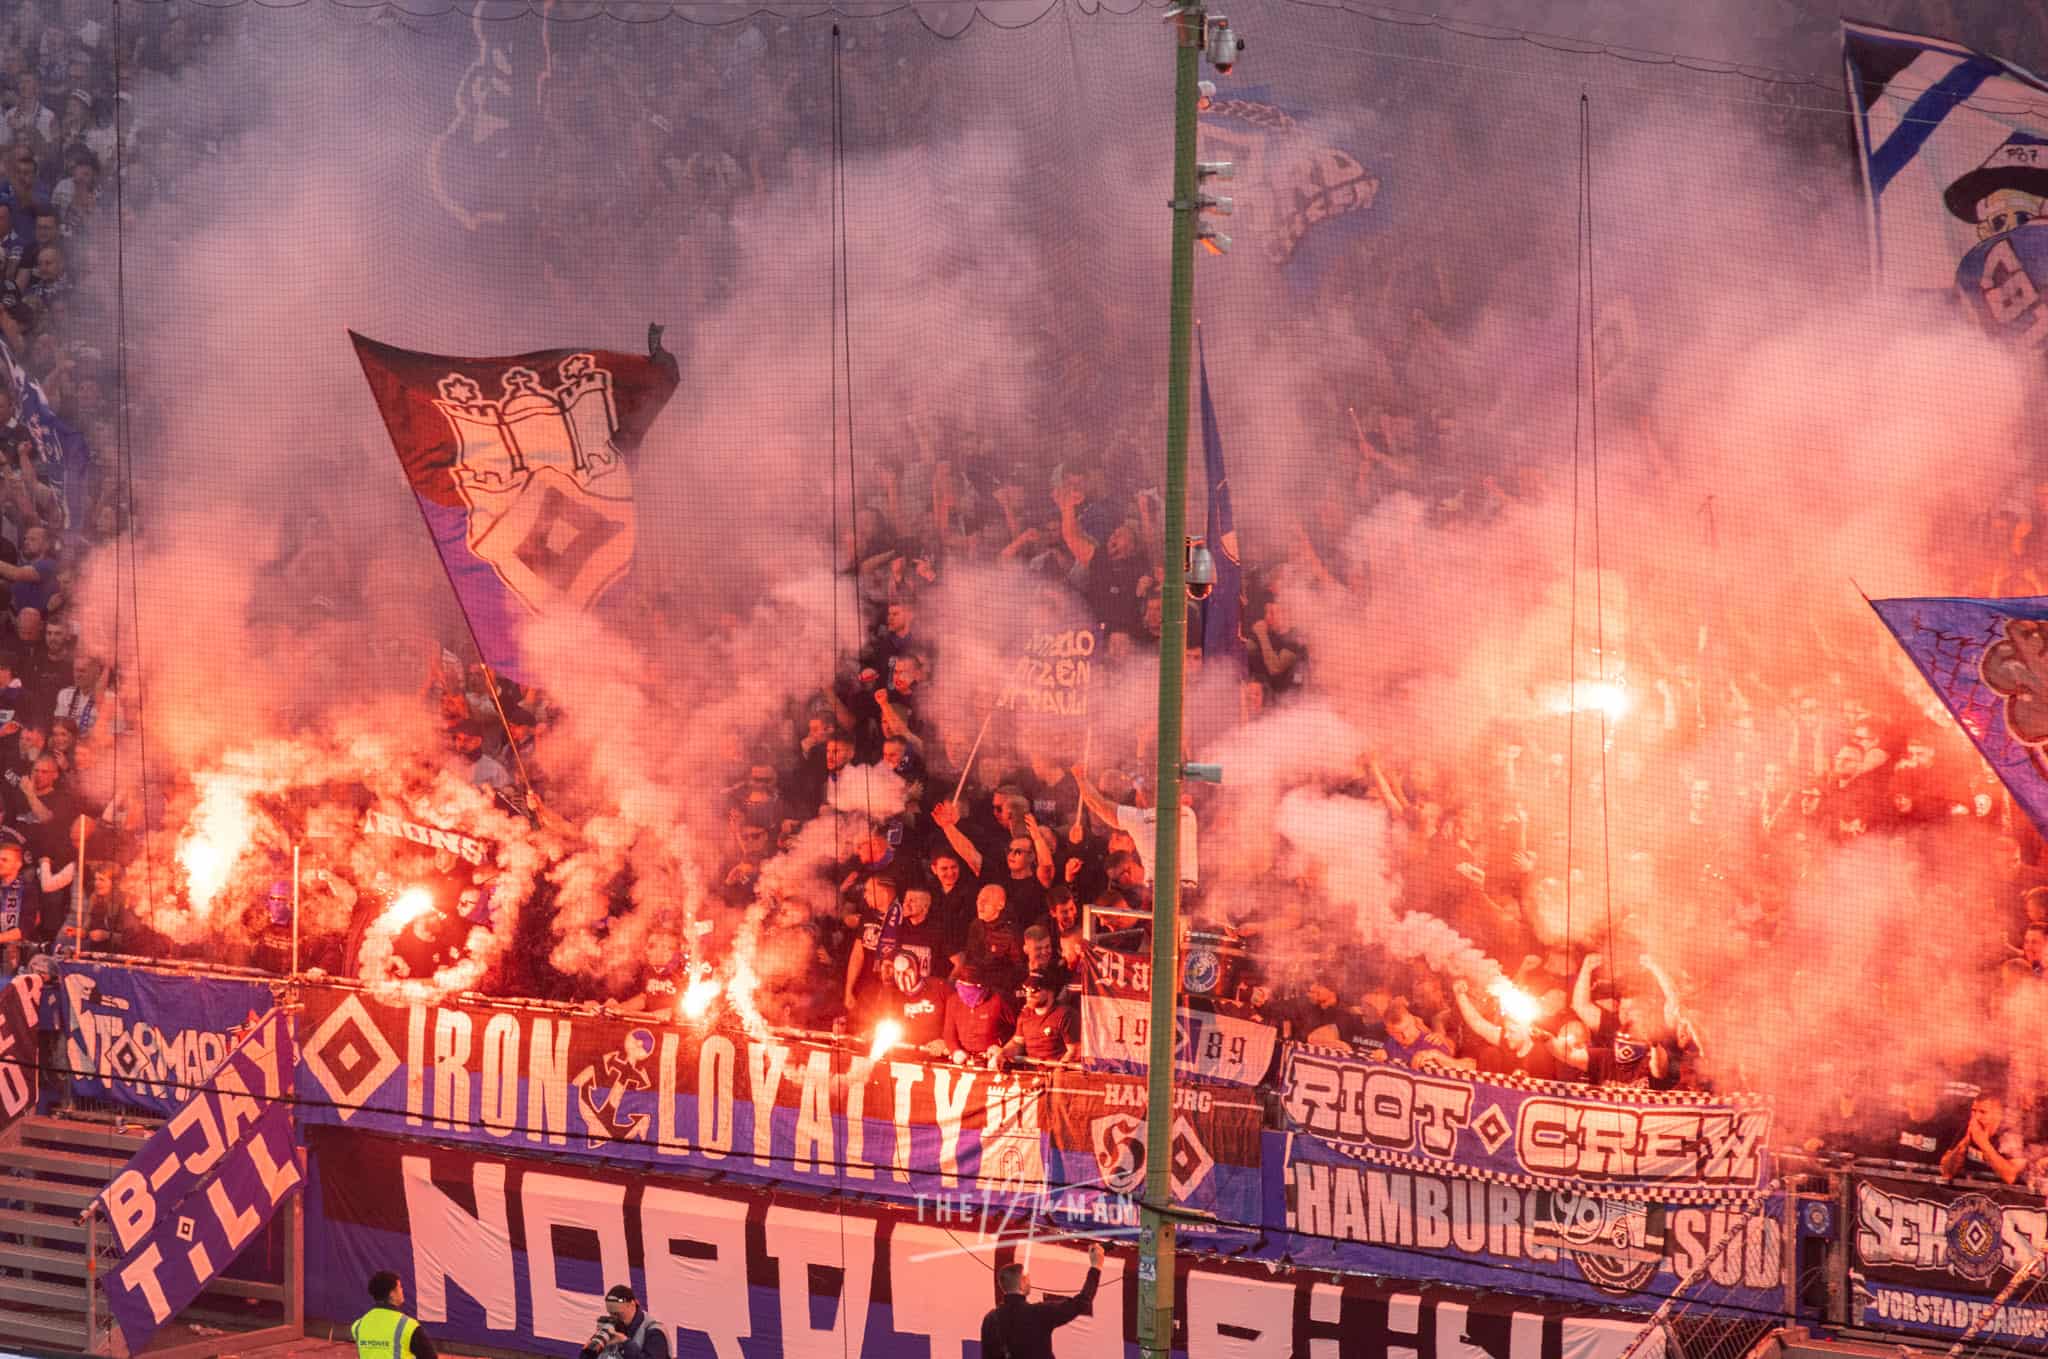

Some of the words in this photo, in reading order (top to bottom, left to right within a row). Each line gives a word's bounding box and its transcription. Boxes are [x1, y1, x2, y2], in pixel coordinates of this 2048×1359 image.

[100, 1016, 281, 1252] B-JAY
[406, 1003, 572, 1146] IRON
[657, 1033, 977, 1188] LOYALTY
[1104, 1083, 1213, 1112] HAMURG
[1285, 1055, 1474, 1159] RIOT
[1516, 1096, 1773, 1188] CREW
[1858, 1181, 1949, 1270] SEK
